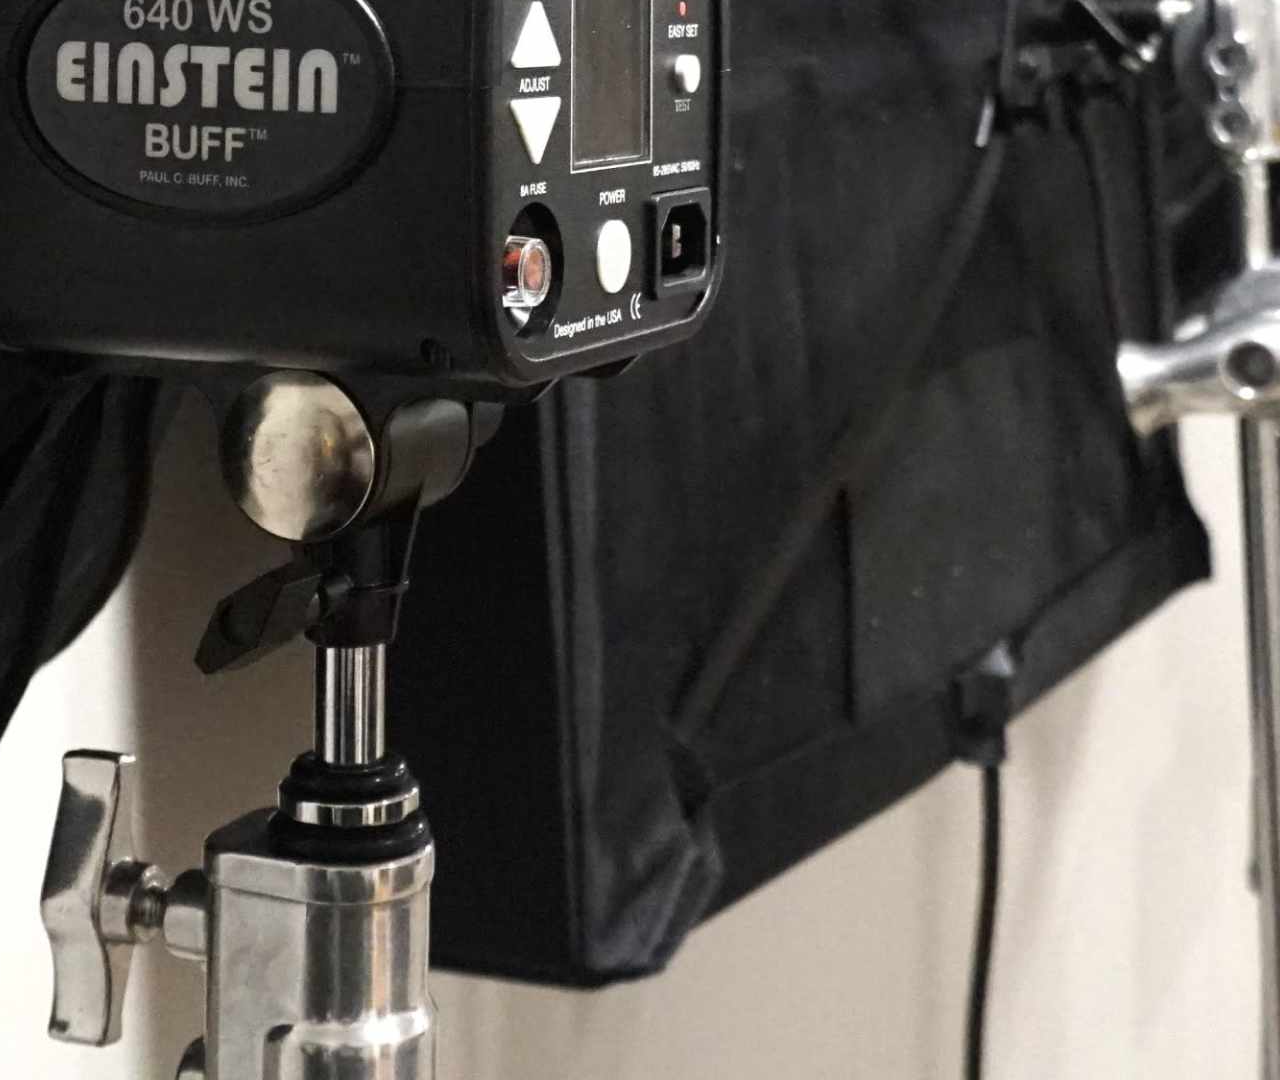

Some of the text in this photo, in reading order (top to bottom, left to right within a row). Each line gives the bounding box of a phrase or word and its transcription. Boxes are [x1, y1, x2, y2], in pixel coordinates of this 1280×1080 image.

[668, 23, 699, 39] EASY SET
[519, 76, 551, 93] ADJUST
[138, 170, 171, 184] PAUL
[225, 175, 250, 189] INC.
[530, 181, 548, 196] FUSE
[599, 189, 627, 207] POWER
[553, 308, 623, 339] Designed in the USA
